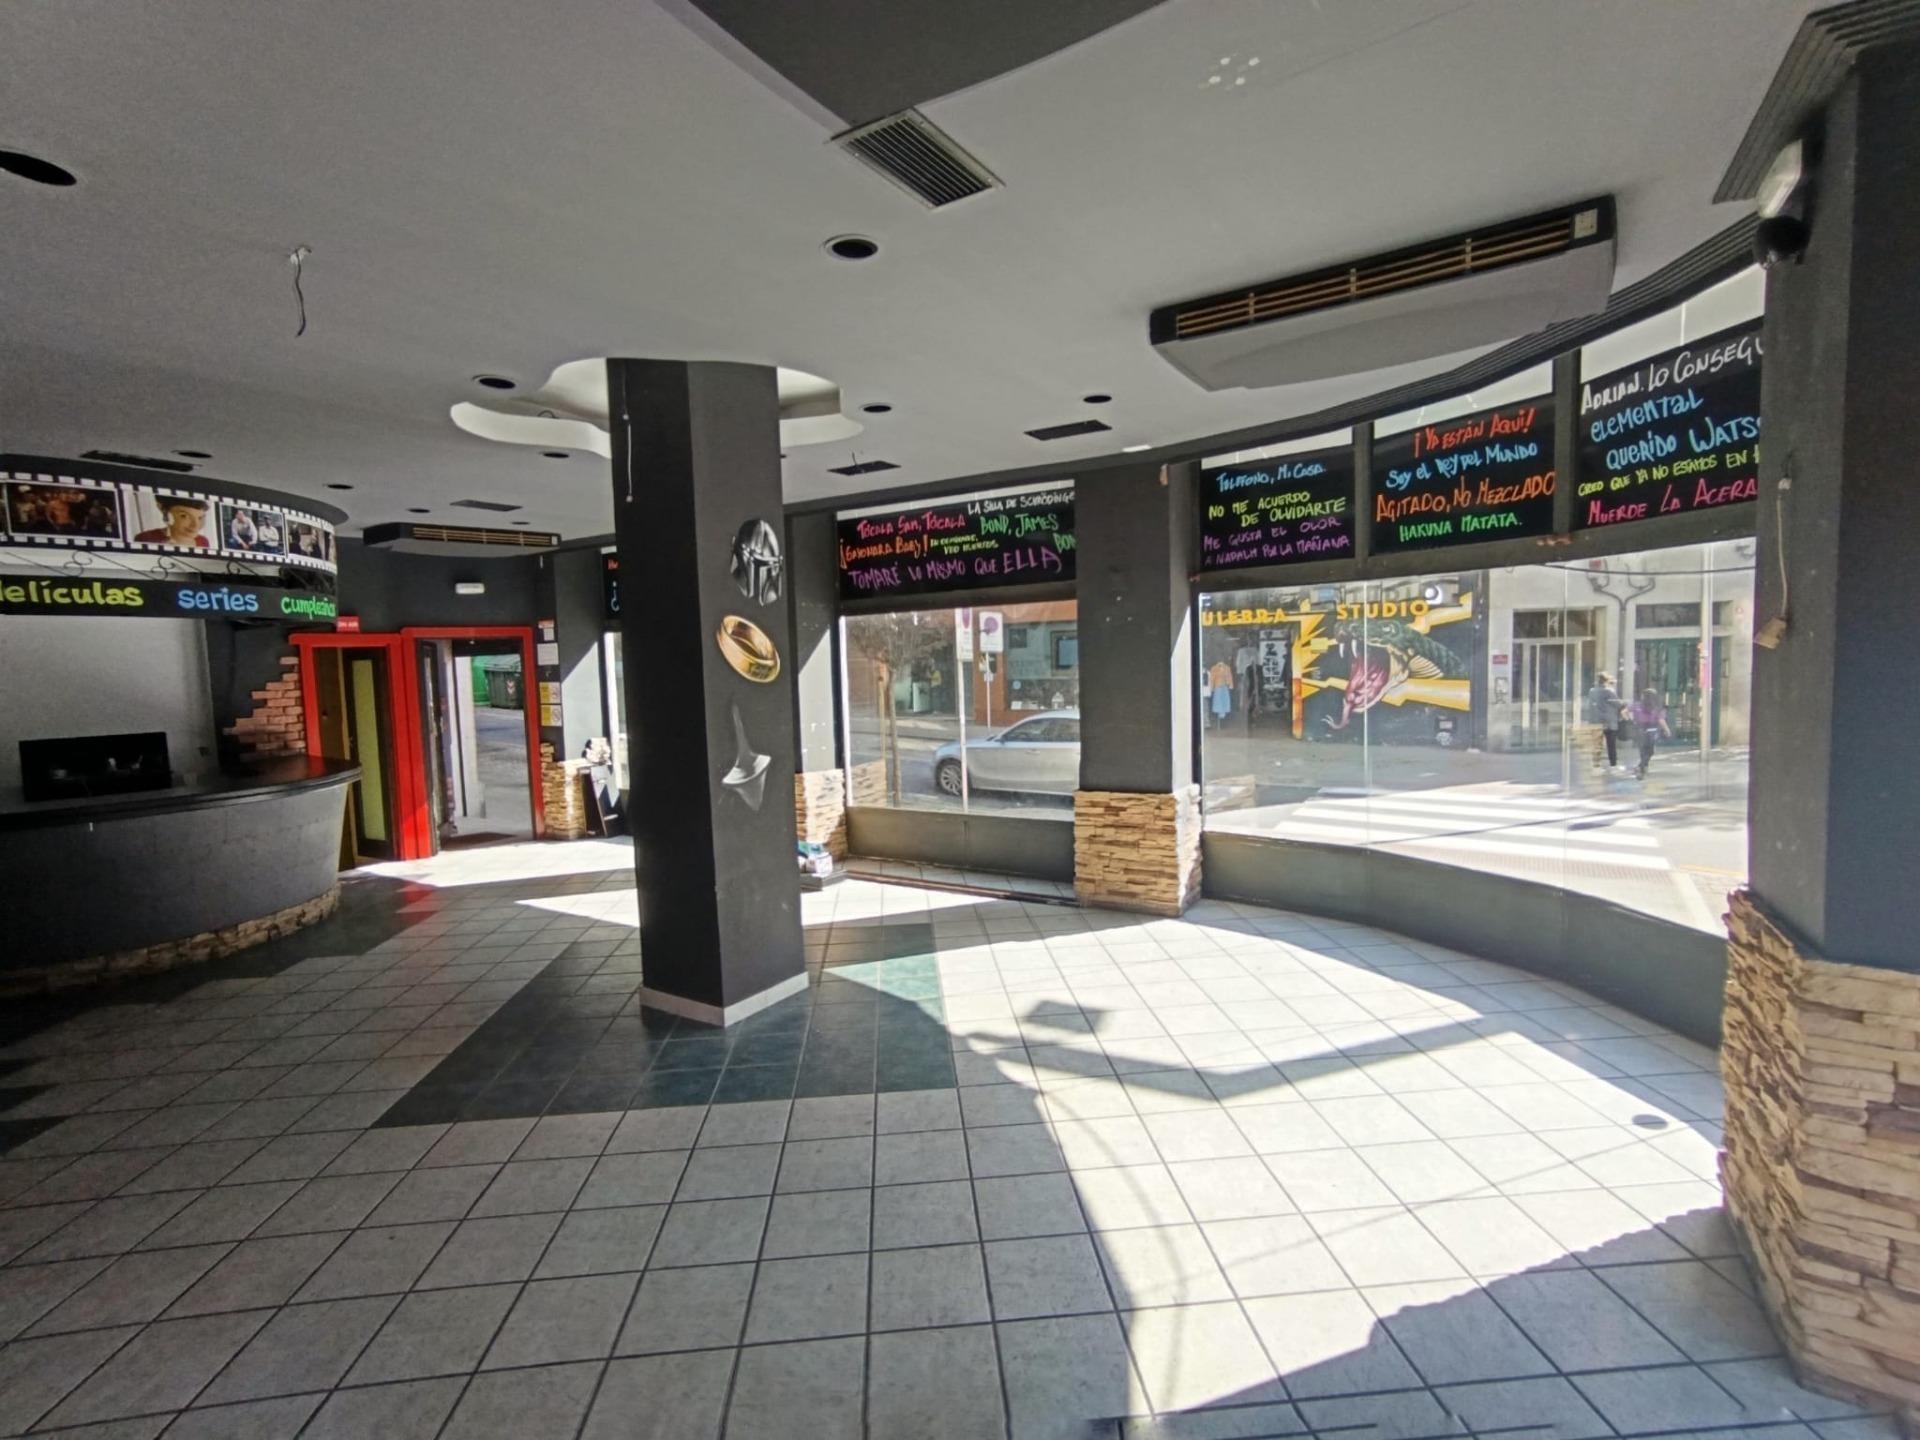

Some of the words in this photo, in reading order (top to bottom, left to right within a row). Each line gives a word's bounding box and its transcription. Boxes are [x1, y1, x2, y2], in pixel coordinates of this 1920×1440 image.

[1648, 364, 1669, 391] LO
[1485, 442, 1538, 465] MUNDO
[1578, 480, 1604, 497] CREO
[1610, 475, 1631, 491] QUE
[1635, 467, 1649, 486] YA
[1652, 464, 1669, 481] NO
[1726, 449, 1748, 469] EN
[1453, 475, 1472, 508] NO
[1476, 470, 1556, 505] MEZCLADO
[1209, 504, 1225, 520] NO
[1232, 499, 1249, 515] ME
[1257, 490, 1311, 510] ACUERDO
[980, 514, 1012, 536] BOND,
[1014, 513, 1059, 538] JAMES
[1241, 512, 1260, 528] DE
[1399, 520, 1452, 543] HAKUNA
[1203, 535, 1221, 552] ME
[1228, 529, 1262, 546] GUSTA
[1271, 527, 1287, 538] EL
[1300, 516, 1342, 533] OLOR
[1279, 543, 1293, 556] LA
[1296, 535, 1351, 554] MAÑANA
[974, 557, 998, 575] QUE
[1003, 546, 1062, 574] ELLA
[0, 579, 144, 606] elículas
[177, 587, 259, 613] series
[1336, 599, 1430, 620] STUDIO
